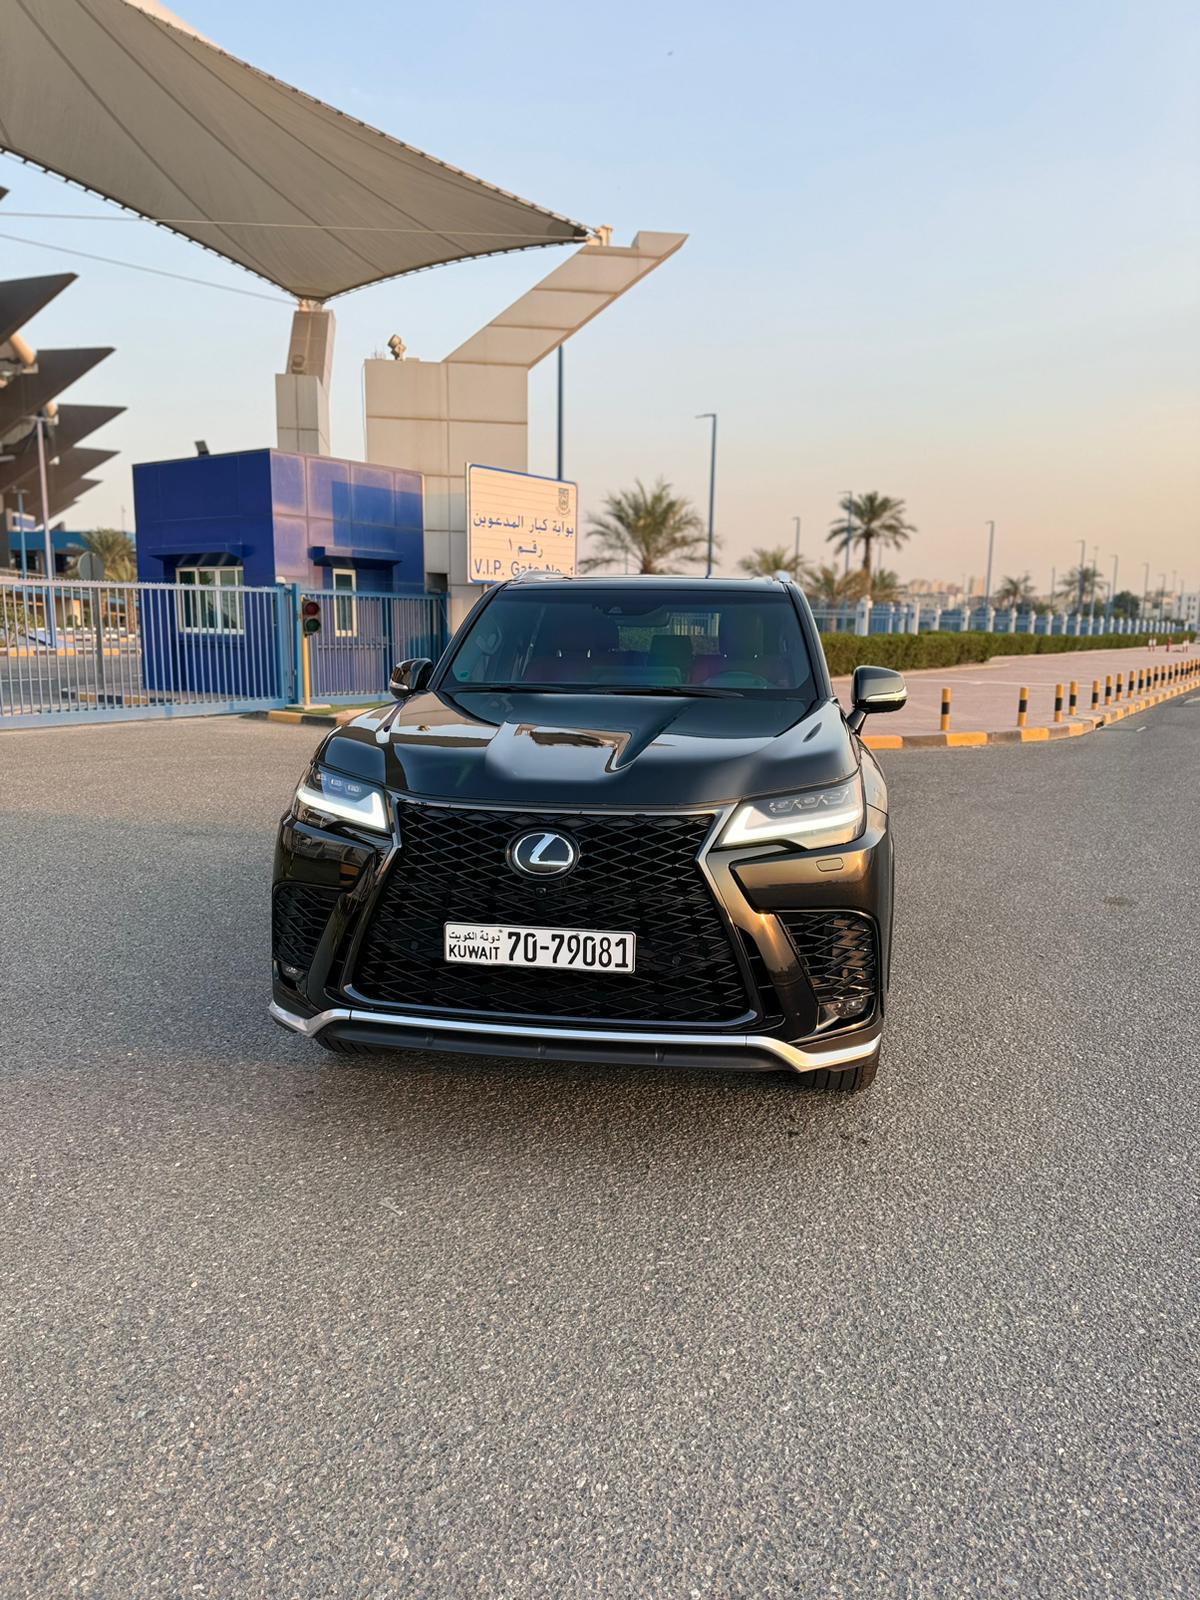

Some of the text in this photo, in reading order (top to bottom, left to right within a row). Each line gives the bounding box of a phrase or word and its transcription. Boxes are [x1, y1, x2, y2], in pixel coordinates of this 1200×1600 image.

[473, 513, 574, 537] بوابة كبار المدعوين
[518, 540, 543, 558] رقم
[474, 558, 505, 576] V.I.P.
[449, 930, 501, 944] دولة الكويت
[448, 944, 500, 960] KUWAIT
[507, 931, 629, 968] 70-79081
